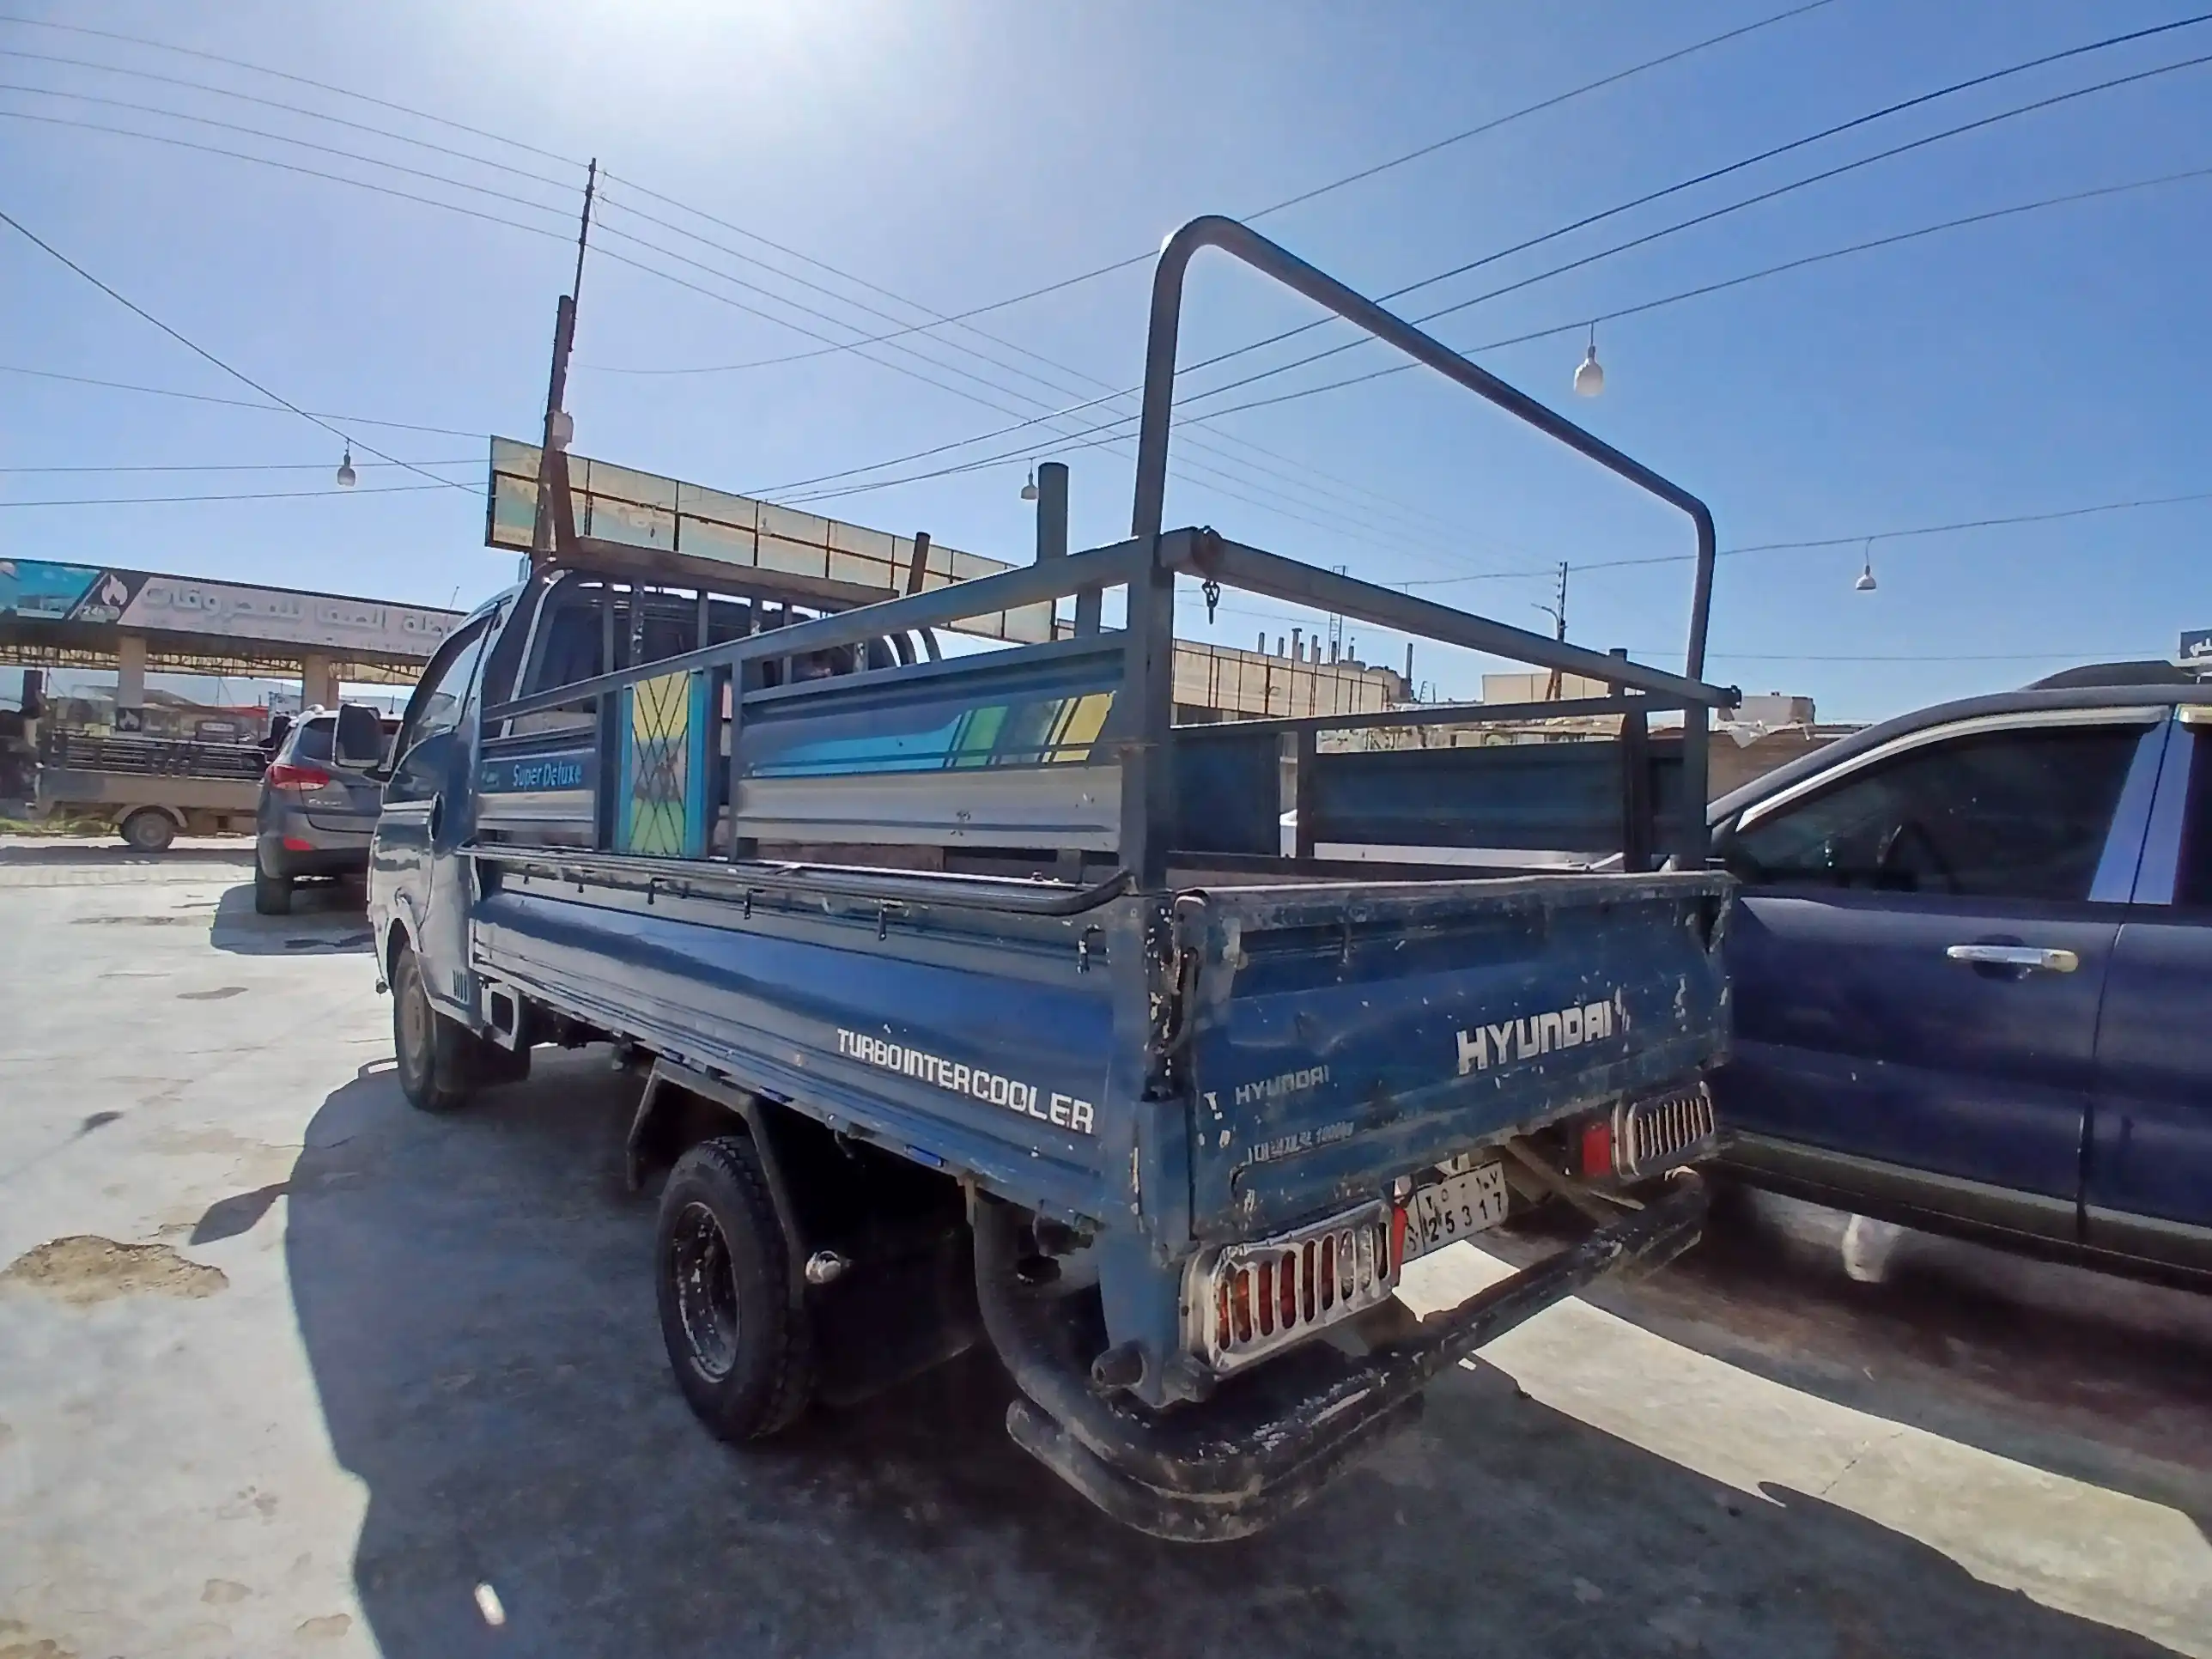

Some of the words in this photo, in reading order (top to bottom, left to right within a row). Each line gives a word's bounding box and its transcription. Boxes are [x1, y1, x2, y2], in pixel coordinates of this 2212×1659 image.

[144, 586, 307, 629] للمحروقات
[401, 614, 459, 640] حطة
[1456, 1000, 1612, 1075] HYUNDAI
[1235, 1065, 1329, 1105] HYUNDAI
[1428, 1192, 1502, 1243] 25317
